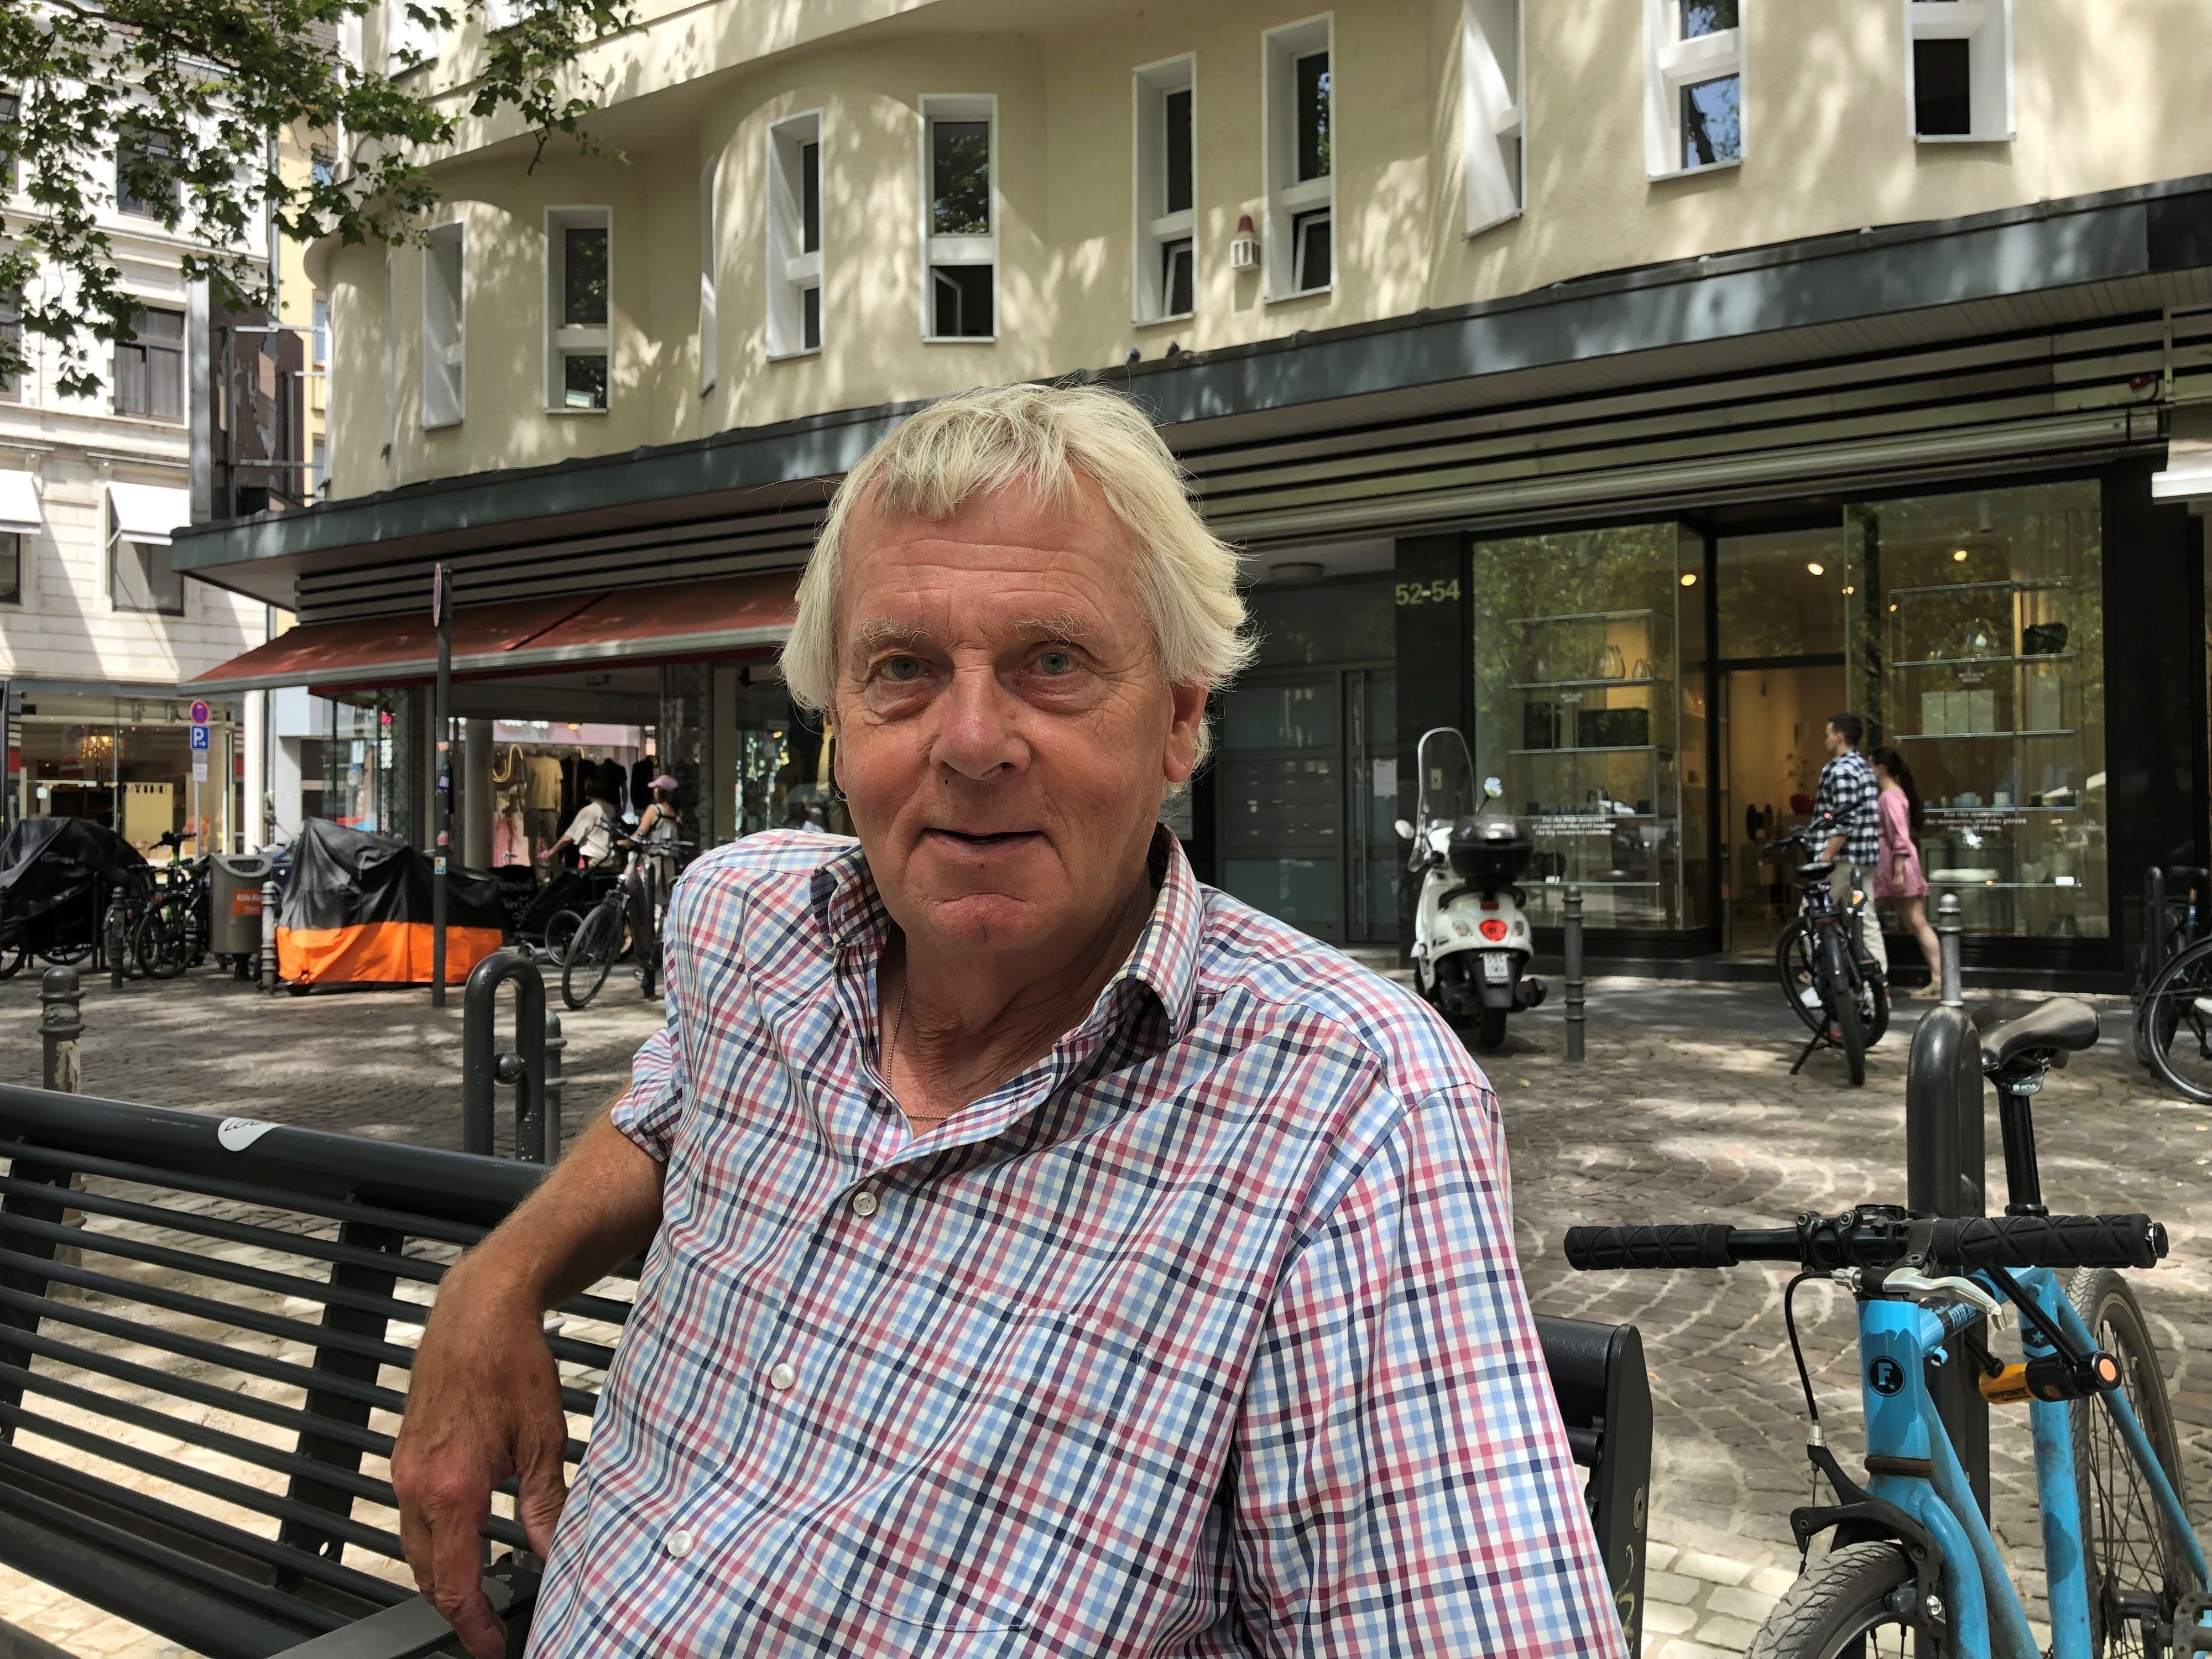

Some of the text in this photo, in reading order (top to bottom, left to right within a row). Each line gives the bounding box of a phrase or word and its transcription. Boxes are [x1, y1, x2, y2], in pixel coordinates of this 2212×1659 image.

[1395, 578, 1460, 606] 52-54
[193, 728, 204, 747] P
[1877, 1363, 1893, 1385] F
